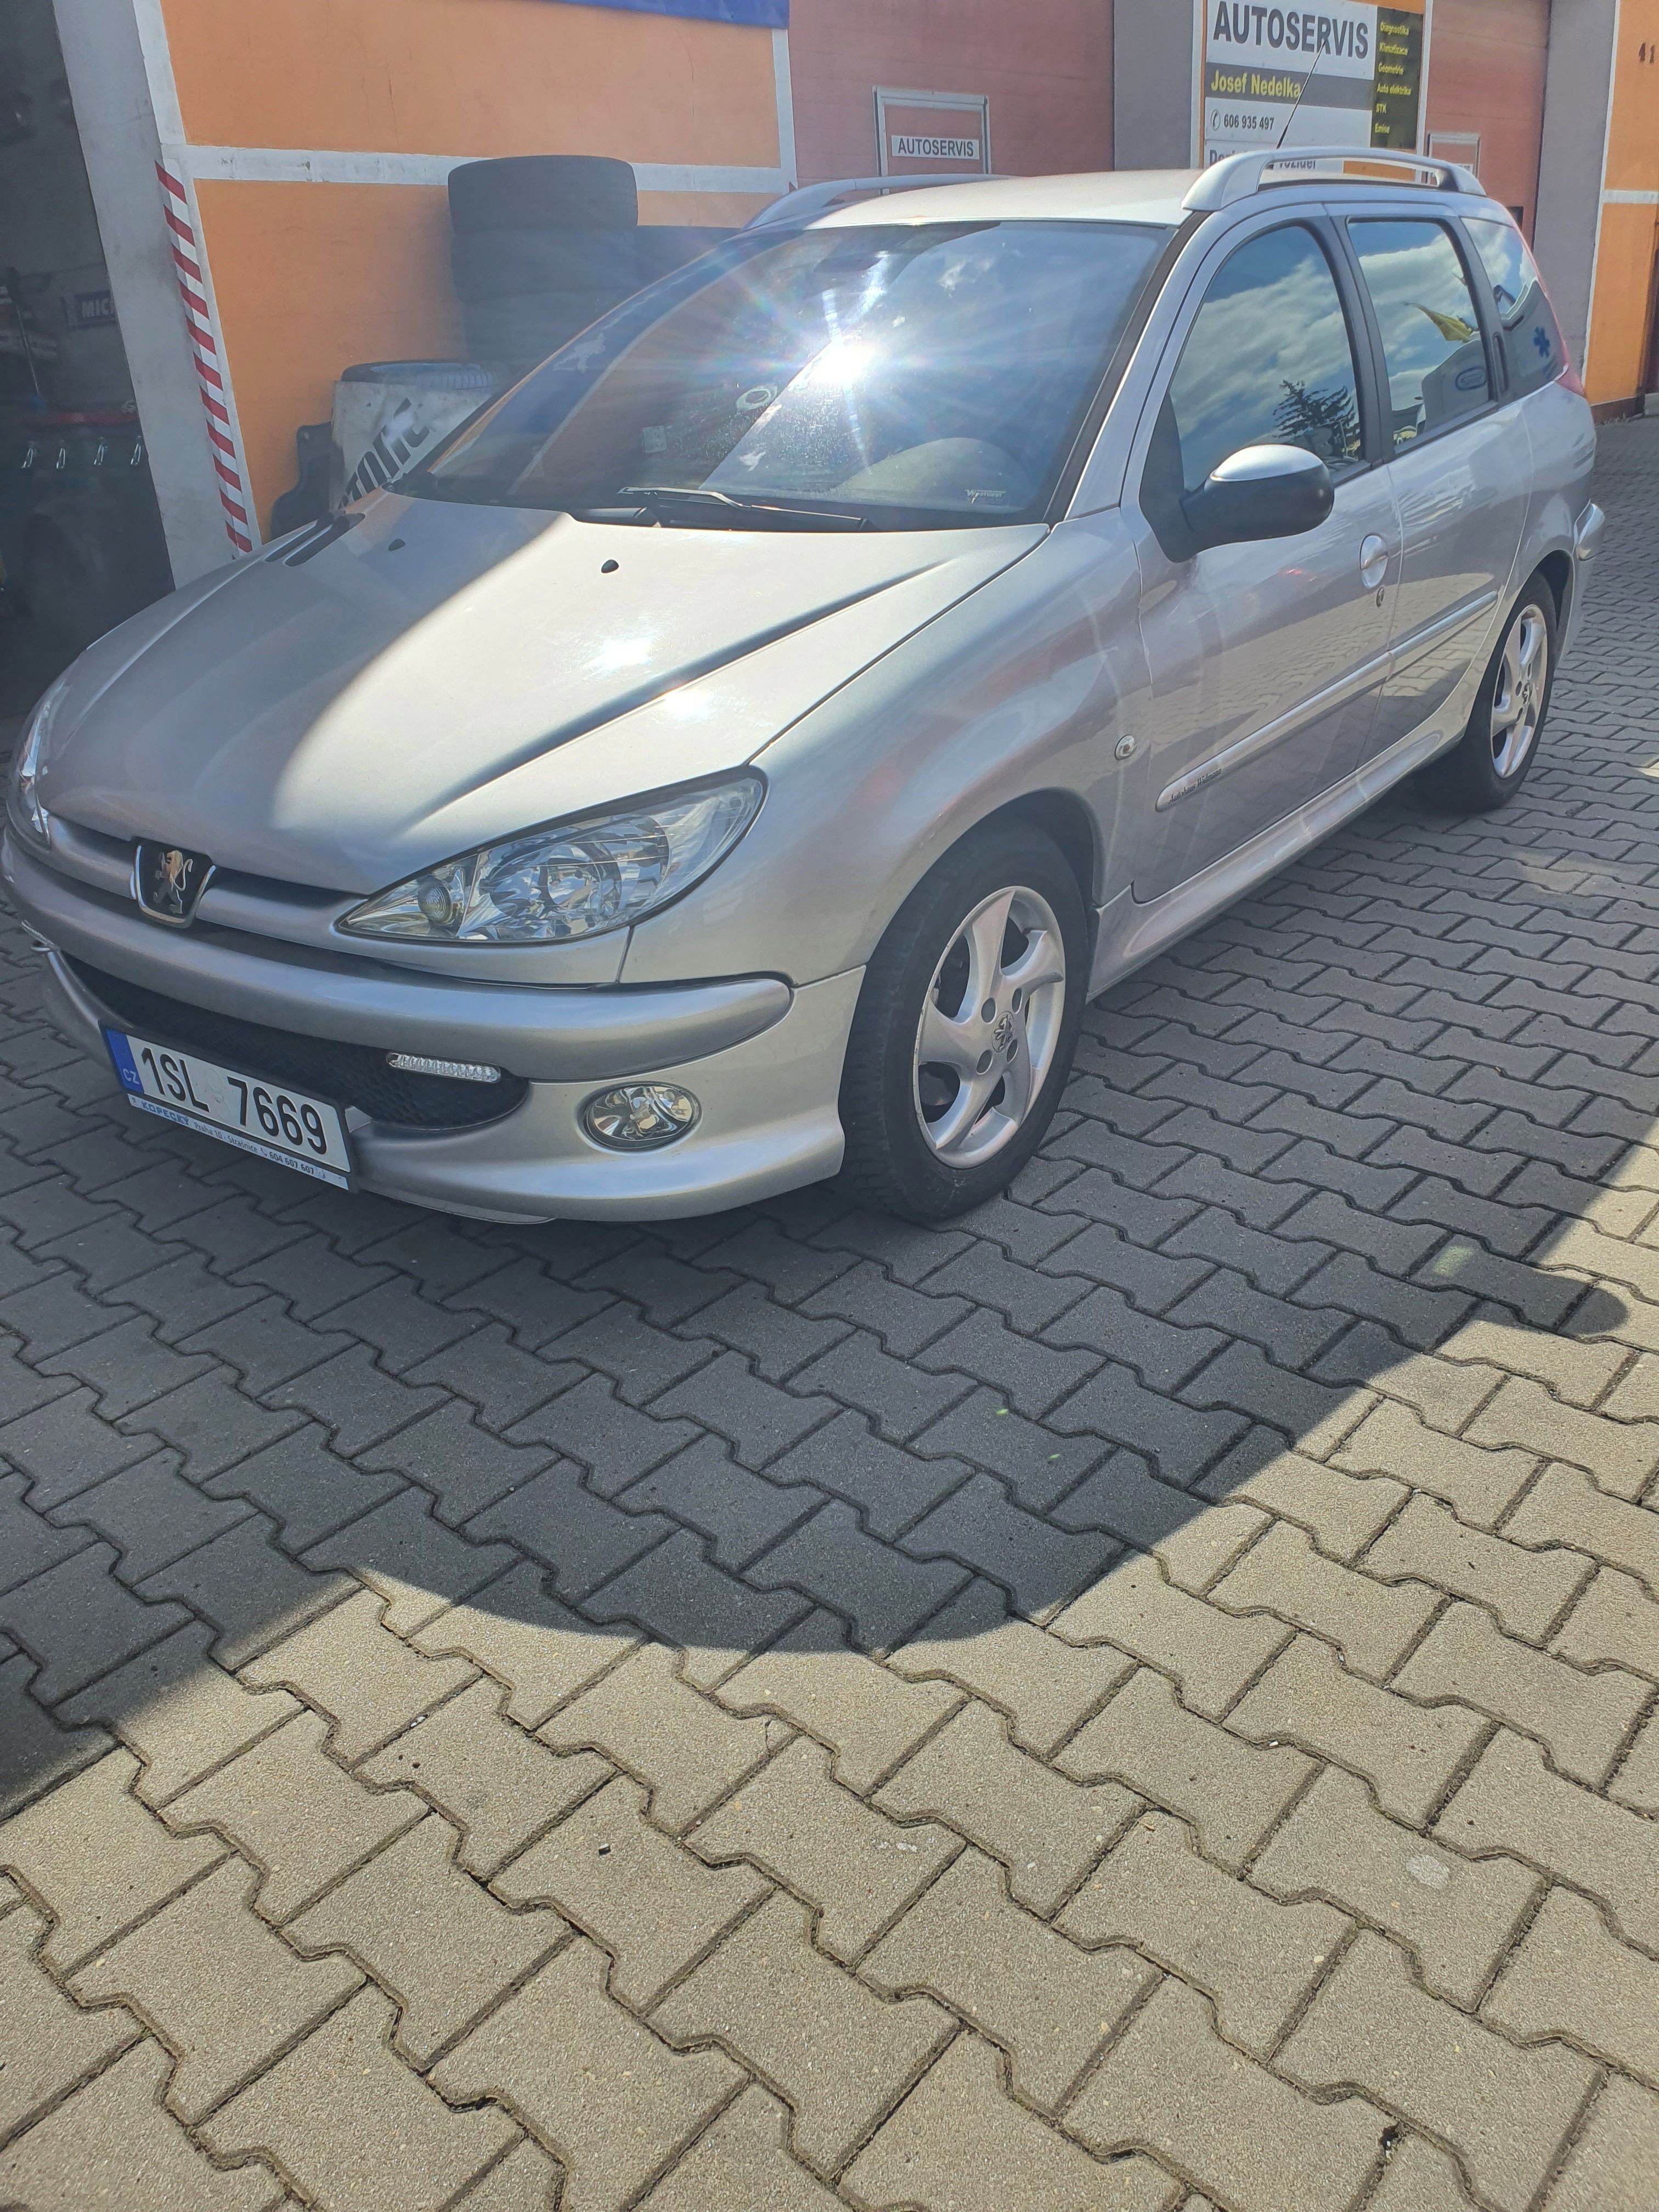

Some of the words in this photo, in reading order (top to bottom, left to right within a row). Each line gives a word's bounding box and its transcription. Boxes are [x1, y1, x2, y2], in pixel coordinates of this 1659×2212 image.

[1212, 1, 1369, 59] AUTOSERVIS
[1380, 21, 1409, 36] Diagnostika
[1379, 42, 1408, 55] Klimatizace
[1378, 62, 1404, 75] Geometrie
[1211, 70, 1247, 93] Josef
[1251, 74, 1301, 98] Nedelka
[1376, 83, 1389, 93] Auto
[1375, 103, 1386, 114] STK
[1223, 114, 1239, 128] 606
[1242, 115, 1257, 129] 935
[1259, 116, 1274, 131] 497
[1374, 123, 1390, 134] Emise
[898, 137, 974, 157] AUTOSERVIS
[122, 1068, 140, 1085] CZ
[141, 1047, 210, 1113] 1SL
[227, 1076, 328, 1155] 7669
[193, 1122, 213, 1136] Praha
[215, 1130, 223, 1139] 10
[228, 1135, 258, 1153] Strašnice
[269, 1153, 283, 1163] 604
[285, 1158, 298, 1169] 607
[301, 1163, 314, 1175] 607
